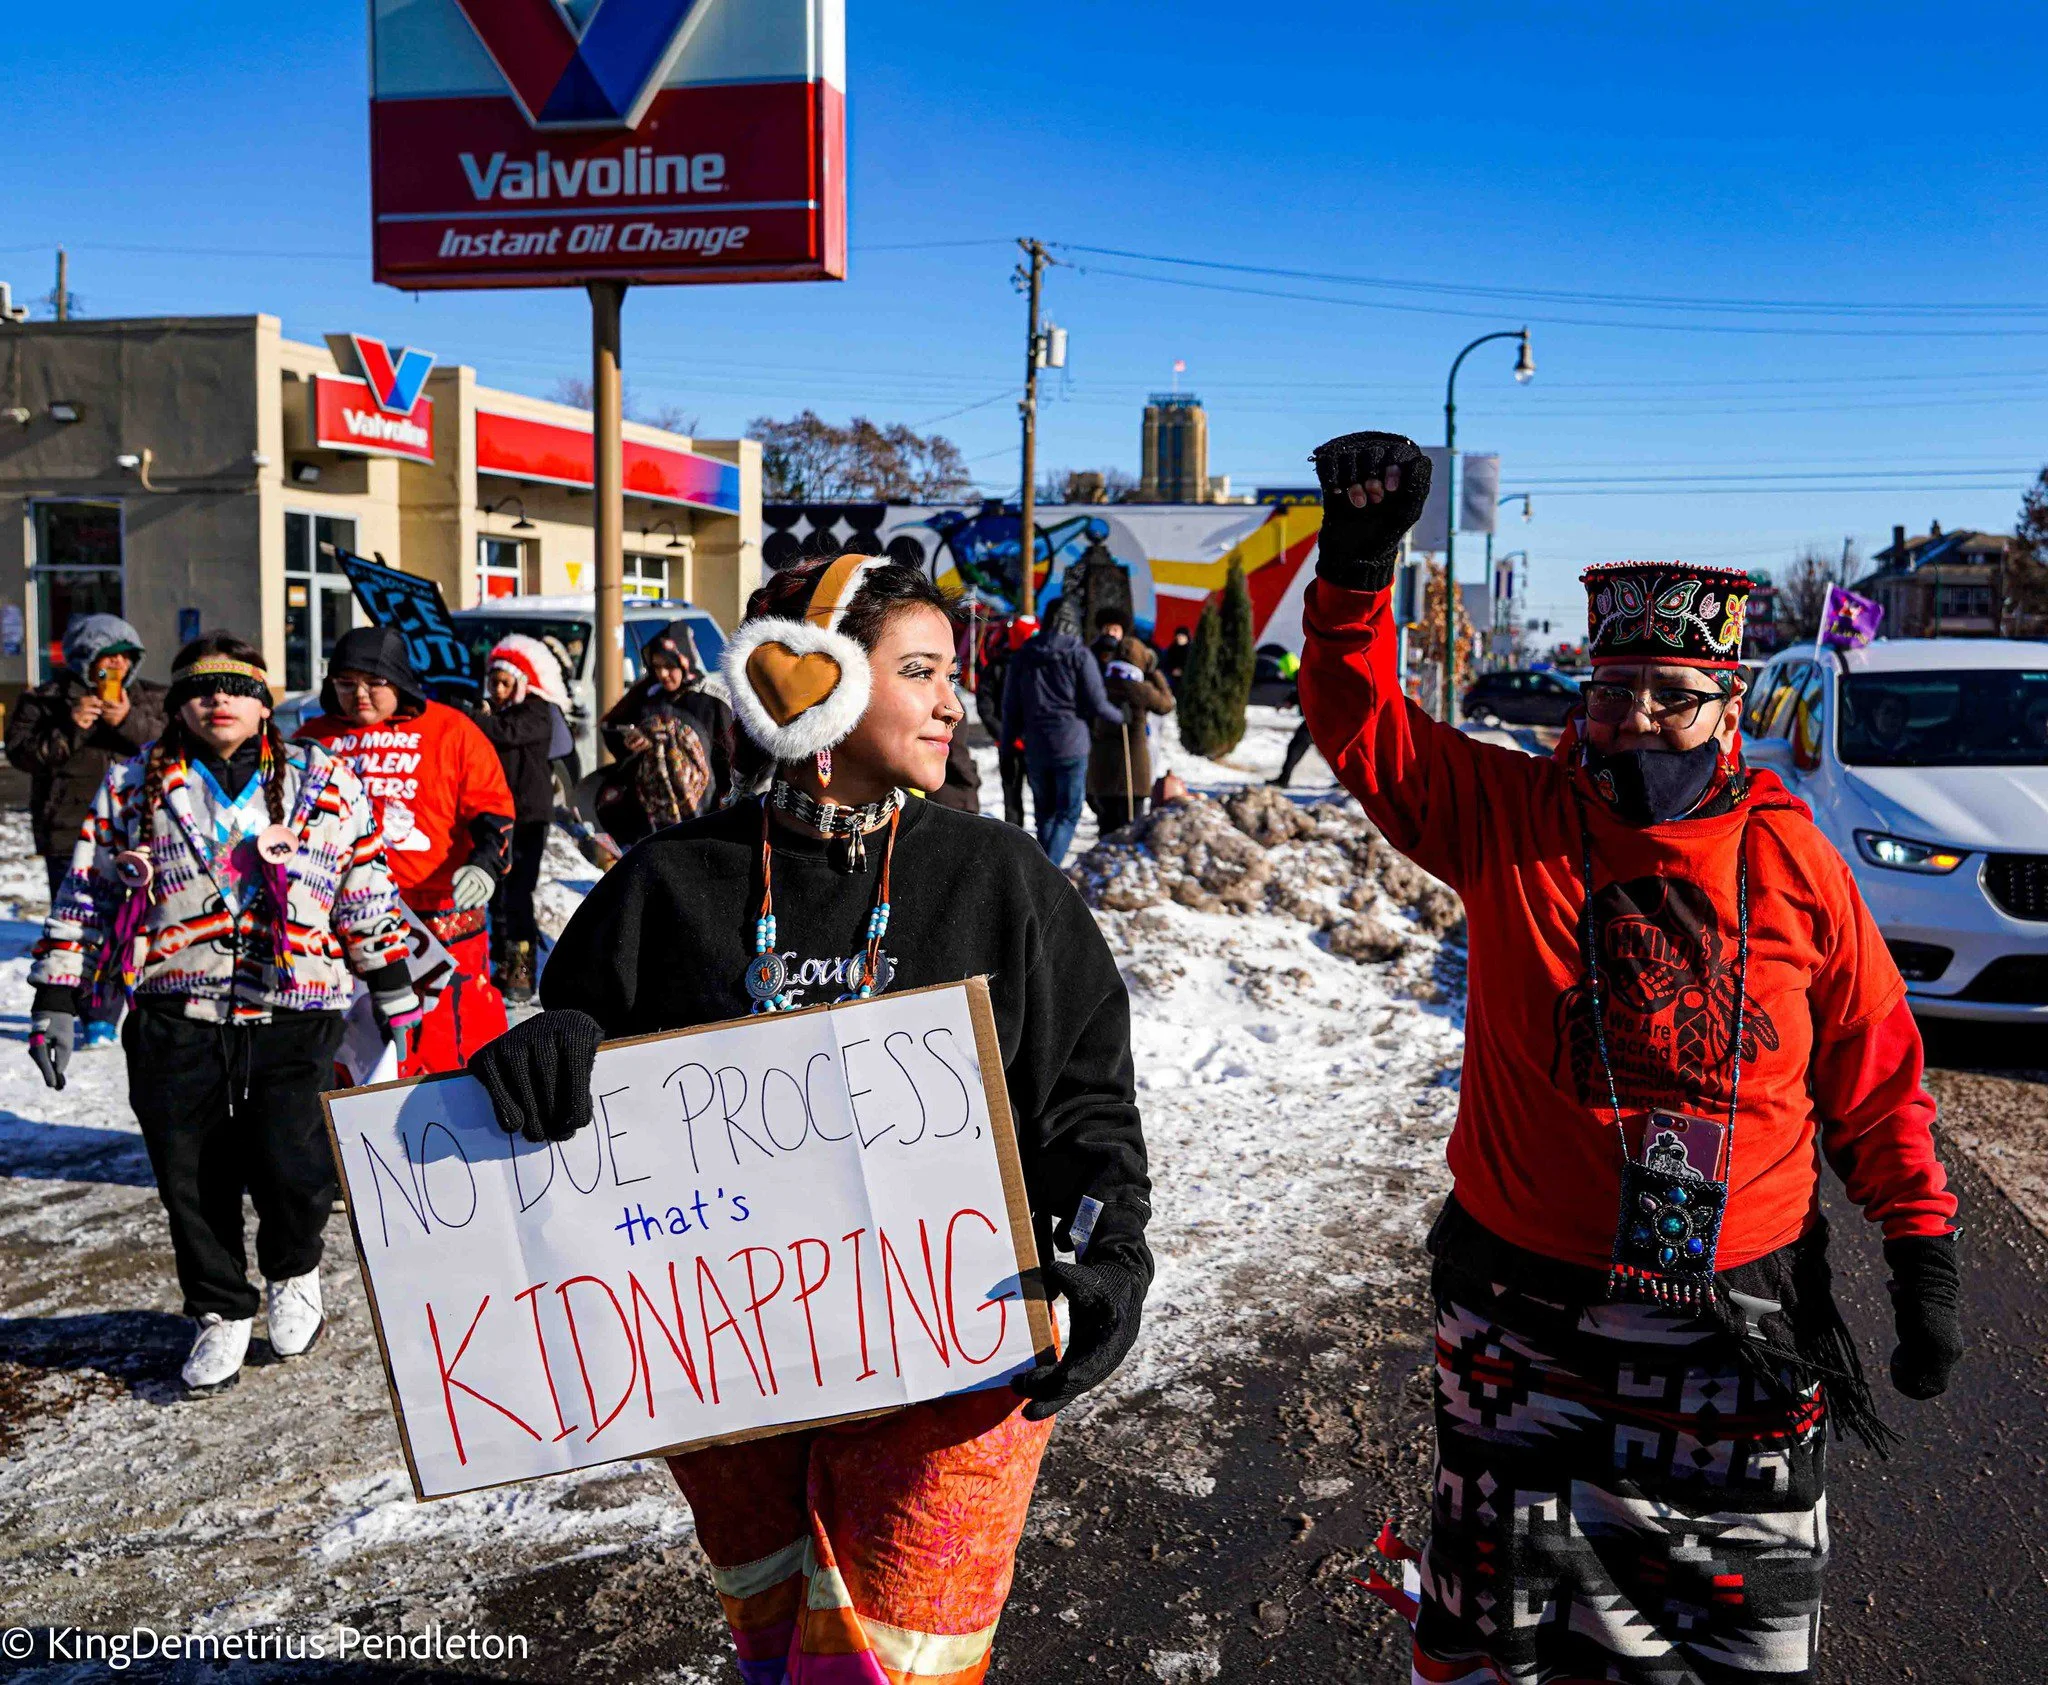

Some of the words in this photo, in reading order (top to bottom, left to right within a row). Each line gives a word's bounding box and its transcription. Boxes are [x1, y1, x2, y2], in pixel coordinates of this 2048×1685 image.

[459, 148, 727, 200] Valvoline
[438, 227, 562, 258] Instant
[566, 224, 614, 256] Oil
[618, 222, 749, 256] Change
[402, 631, 472, 675] UT!
[331, 734, 358, 752] NO
[360, 731, 422, 749] MORE
[362, 776, 419, 800] TERS
[1640, 1018, 1671, 1041] Are
[360, 1121, 477, 1248] NO
[508, 1085, 652, 1213] DUE
[662, 1027, 982, 1176] PROCESS,
[614, 1187, 750, 1246] that's
[425, 1208, 1017, 1466] KIDNAPPING
